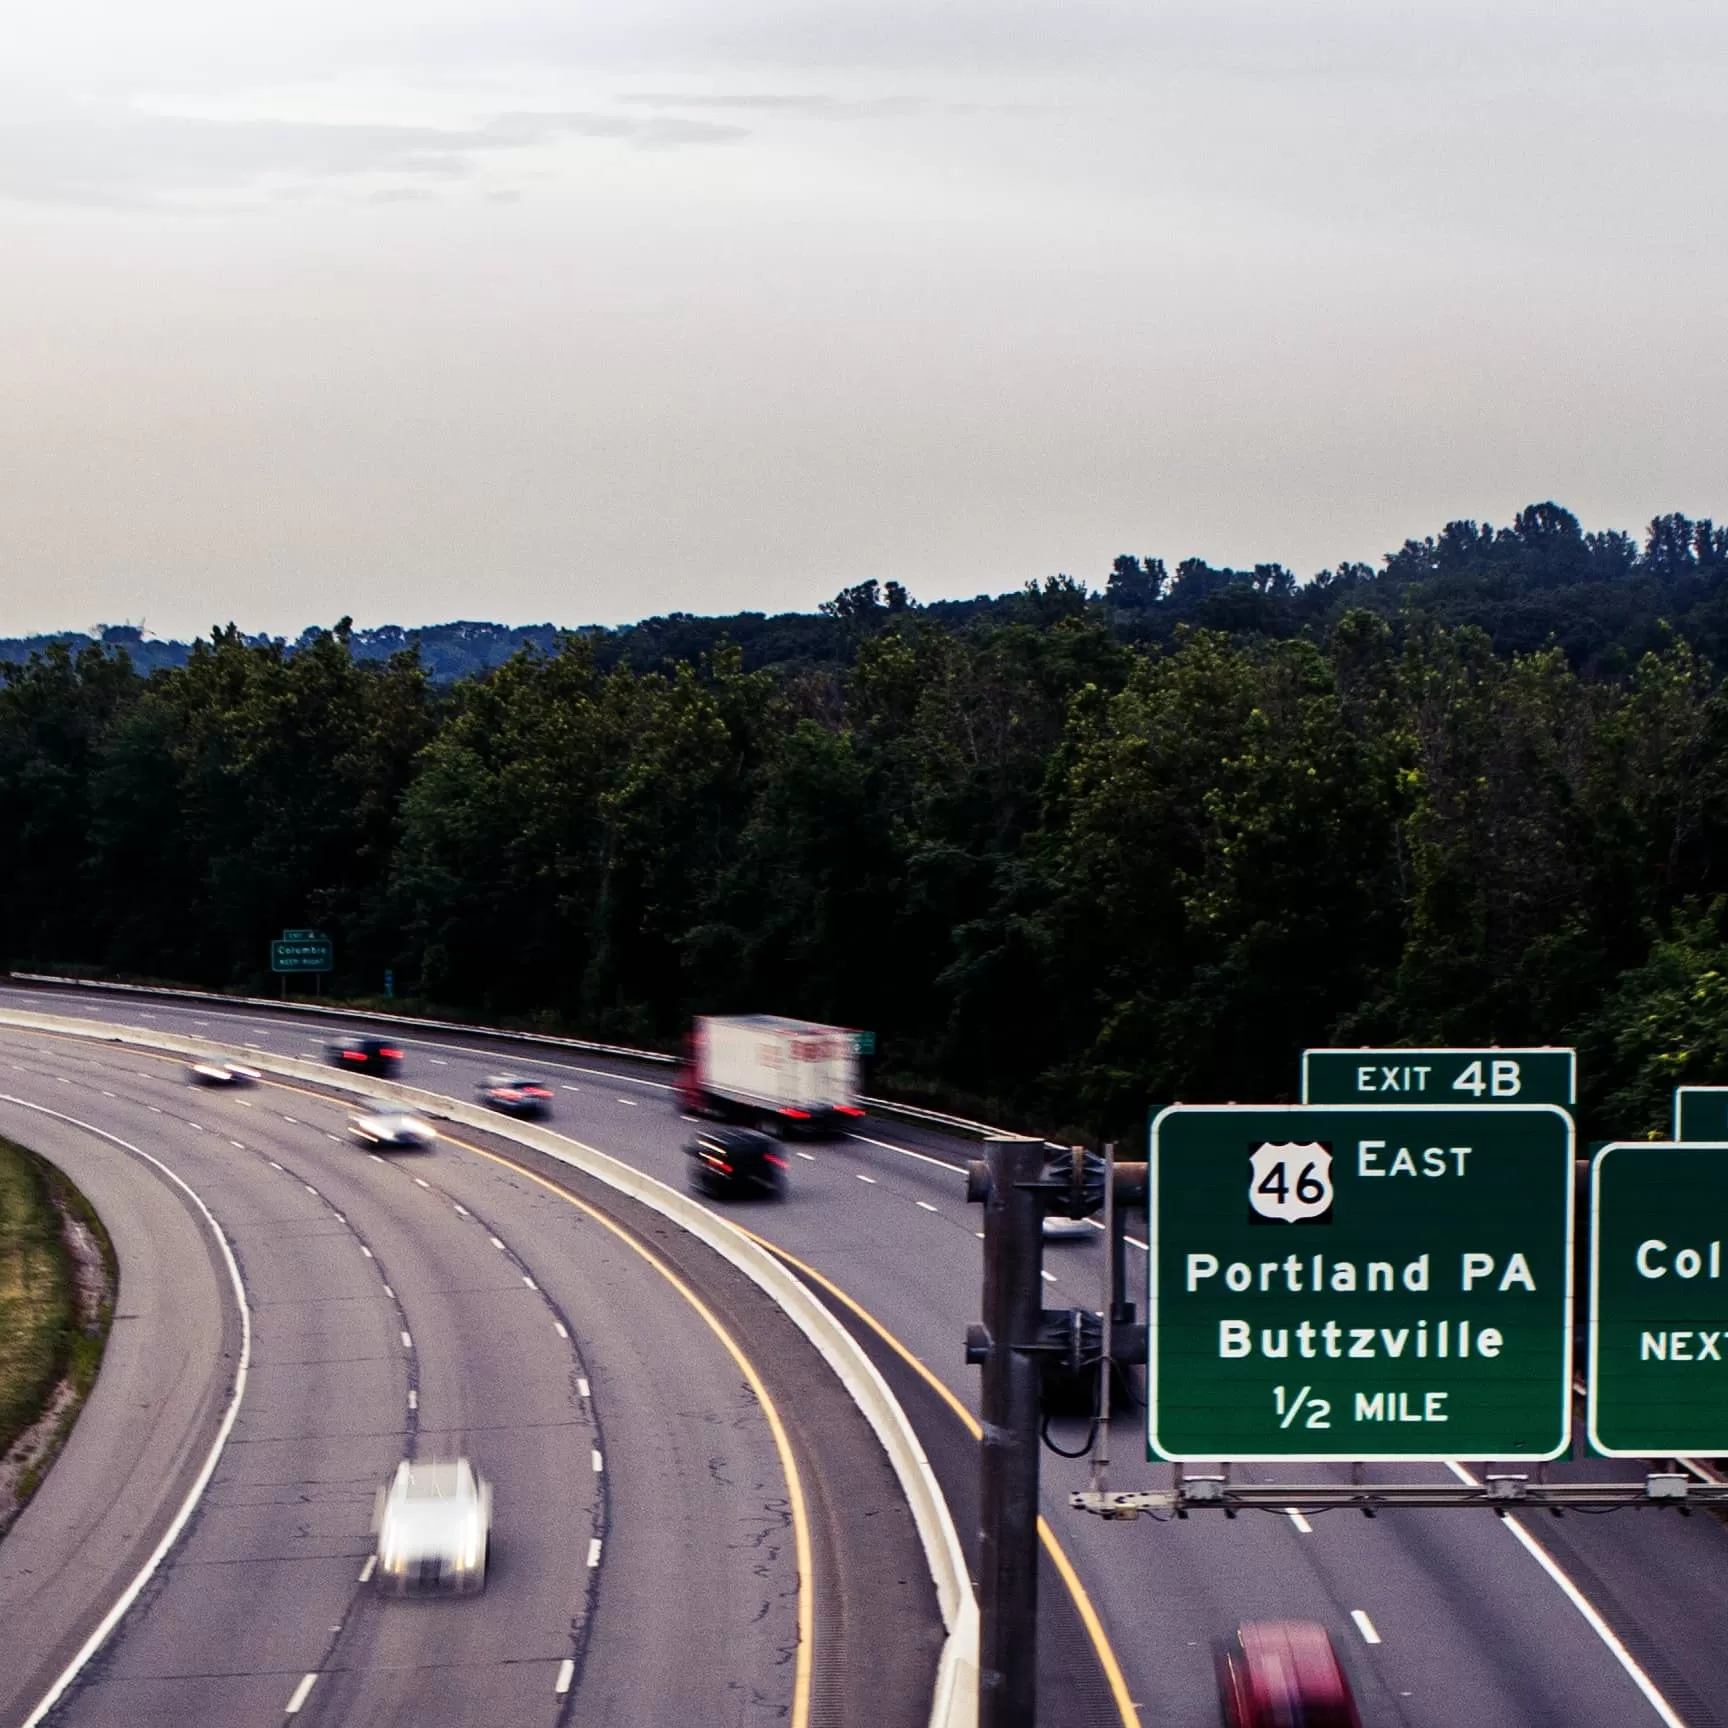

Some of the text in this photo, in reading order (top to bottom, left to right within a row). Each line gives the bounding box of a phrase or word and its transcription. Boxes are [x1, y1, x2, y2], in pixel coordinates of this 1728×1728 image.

[1358, 1060, 1522, 1097] EXIT 4B
[1258, 1140, 1473, 1205] 46 EAST
[1187, 1252, 1537, 1292] Portland PA
[1219, 1319, 1504, 1359] Buttzville
[1355, 1391, 1449, 1422] MILE
